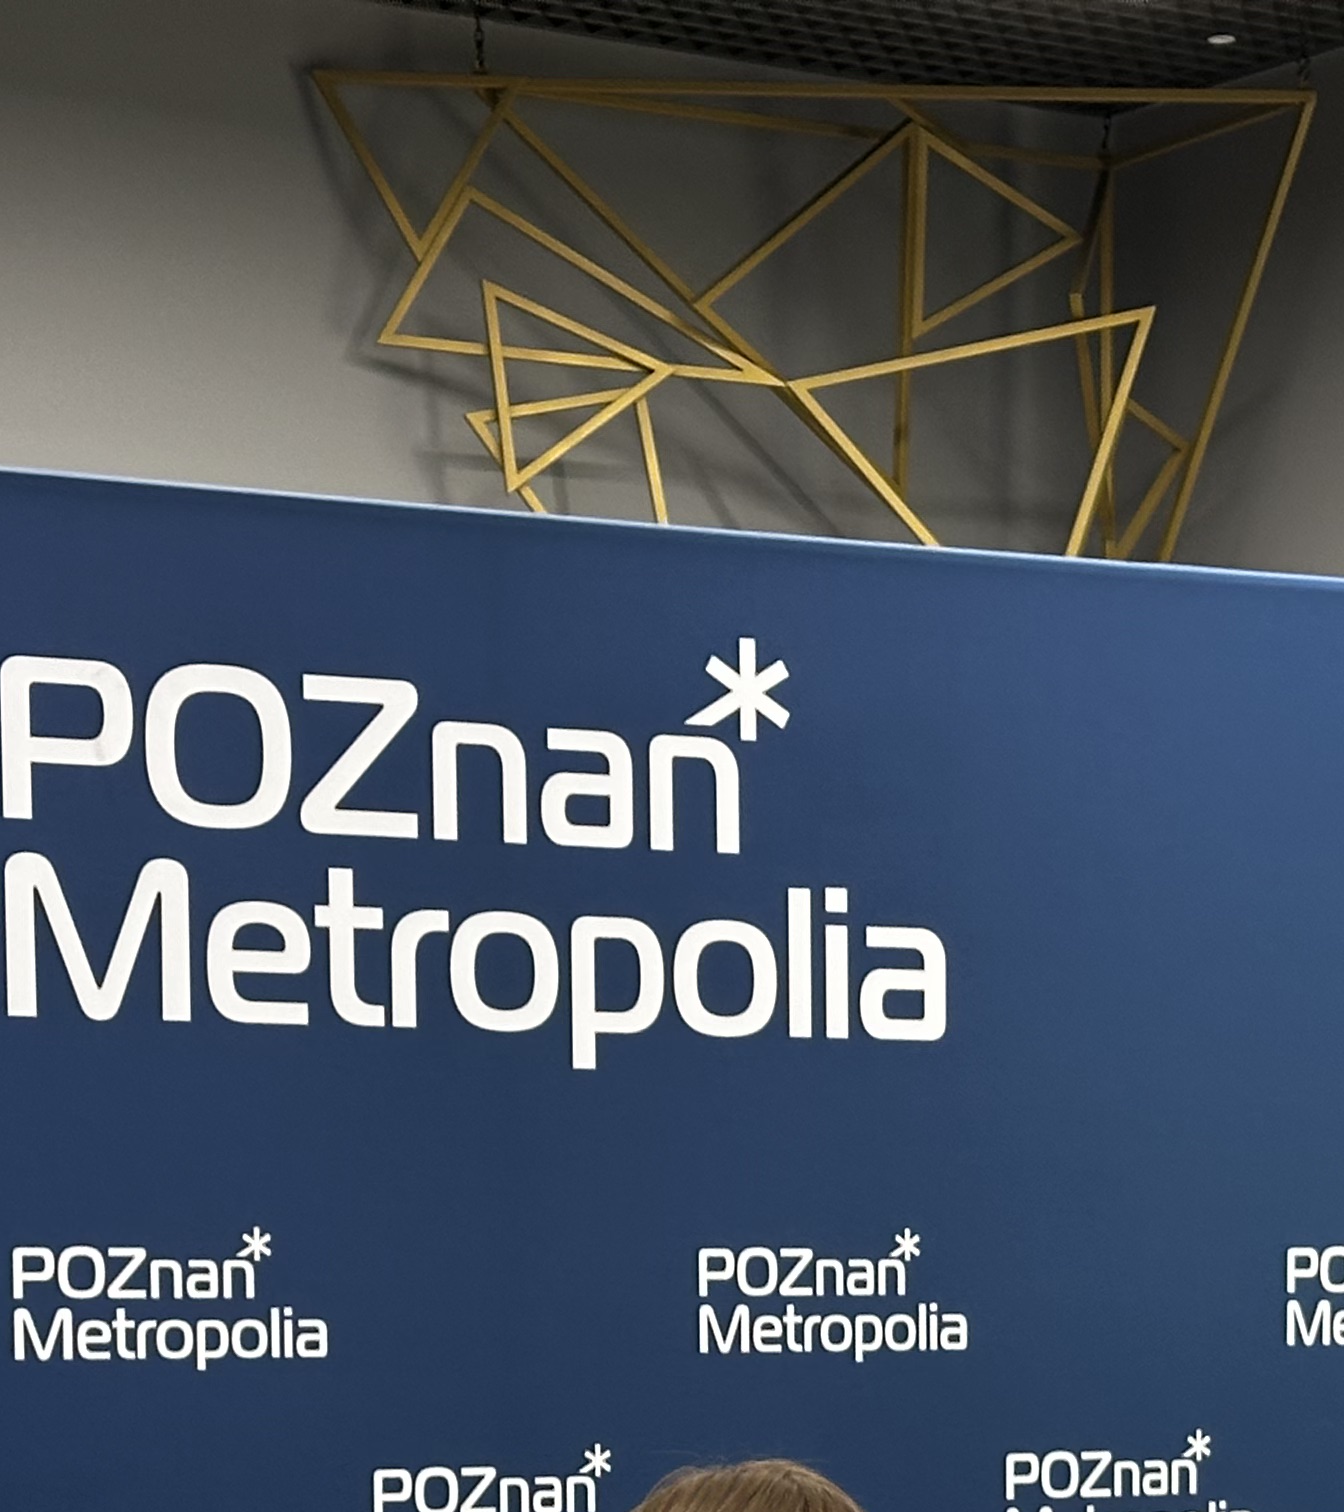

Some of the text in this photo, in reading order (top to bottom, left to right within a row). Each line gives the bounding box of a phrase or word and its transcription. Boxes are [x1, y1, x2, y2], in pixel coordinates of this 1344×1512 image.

[4, 851, 947, 1070] Metropolia
[13, 1306, 329, 1372] Metropolia
[698, 1301, 968, 1363] Metropolia
